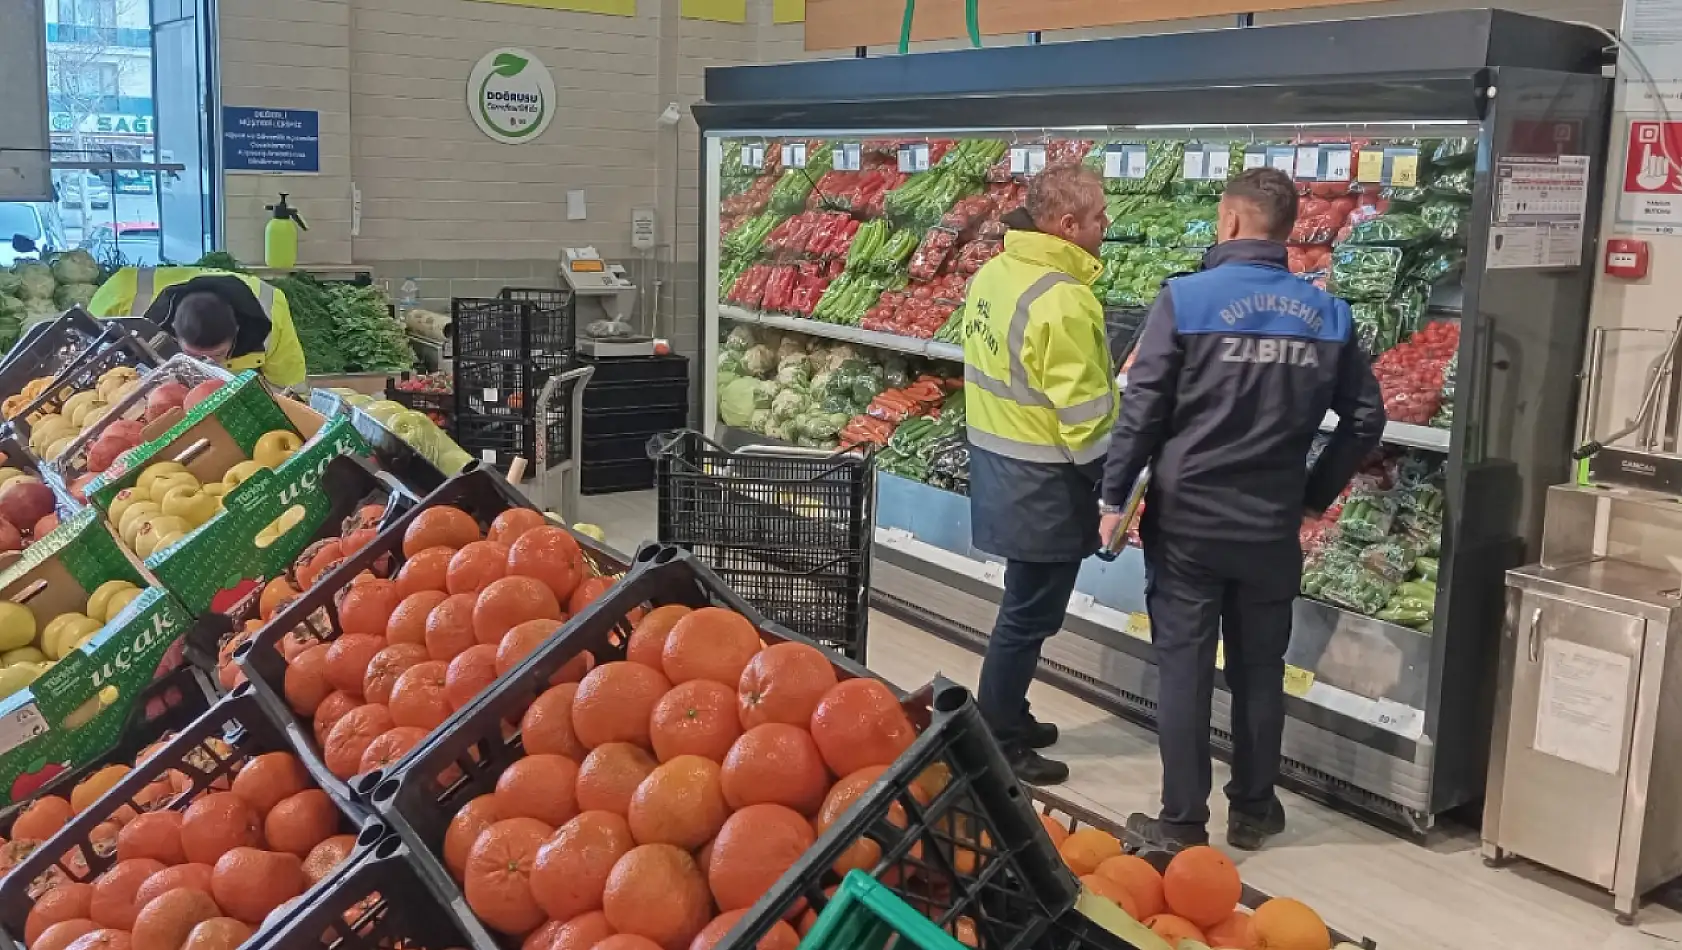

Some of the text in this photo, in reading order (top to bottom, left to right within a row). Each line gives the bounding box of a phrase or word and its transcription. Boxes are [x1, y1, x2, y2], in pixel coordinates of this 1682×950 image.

[487, 91, 538, 103] DOĞRUSU
[1220, 292, 1323, 333] BÜYÜKŞEHİR
[1221, 337, 1319, 368] ZABITA
[89, 606, 175, 687] uçak
